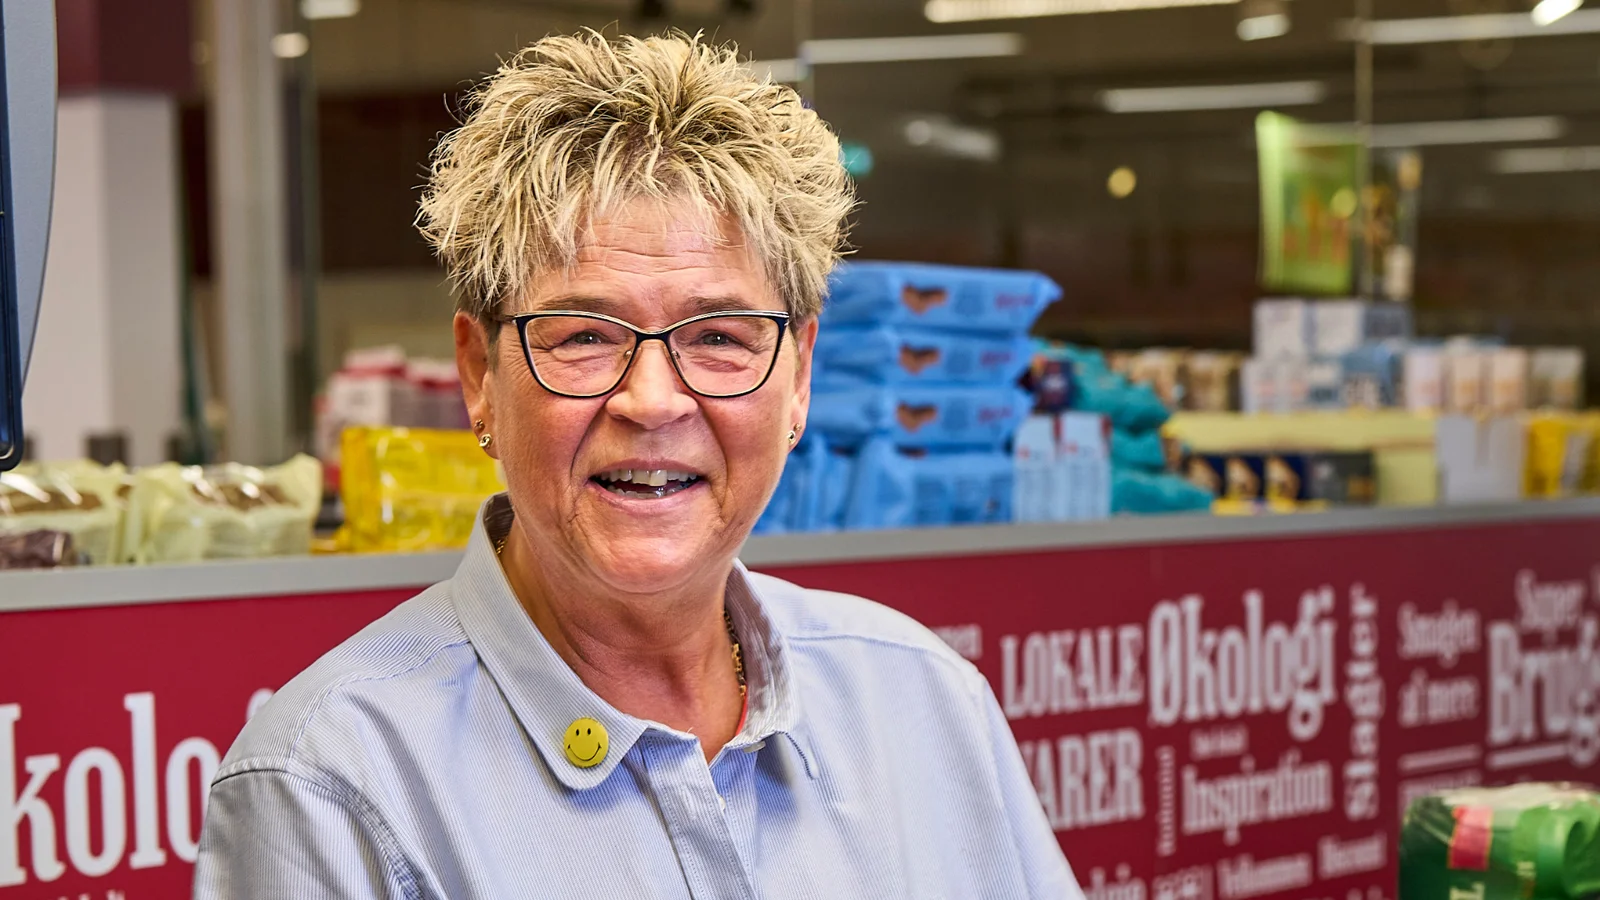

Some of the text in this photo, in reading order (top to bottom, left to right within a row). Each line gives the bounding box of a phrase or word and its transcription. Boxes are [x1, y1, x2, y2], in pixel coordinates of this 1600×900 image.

[1001, 624, 1143, 718] LOKALE
[1149, 588, 1336, 741] Økologi
[1345, 583, 1383, 818] Slagter
[1022, 727, 1144, 830] ARER
[1182, 749, 1332, 845] Inspiration
